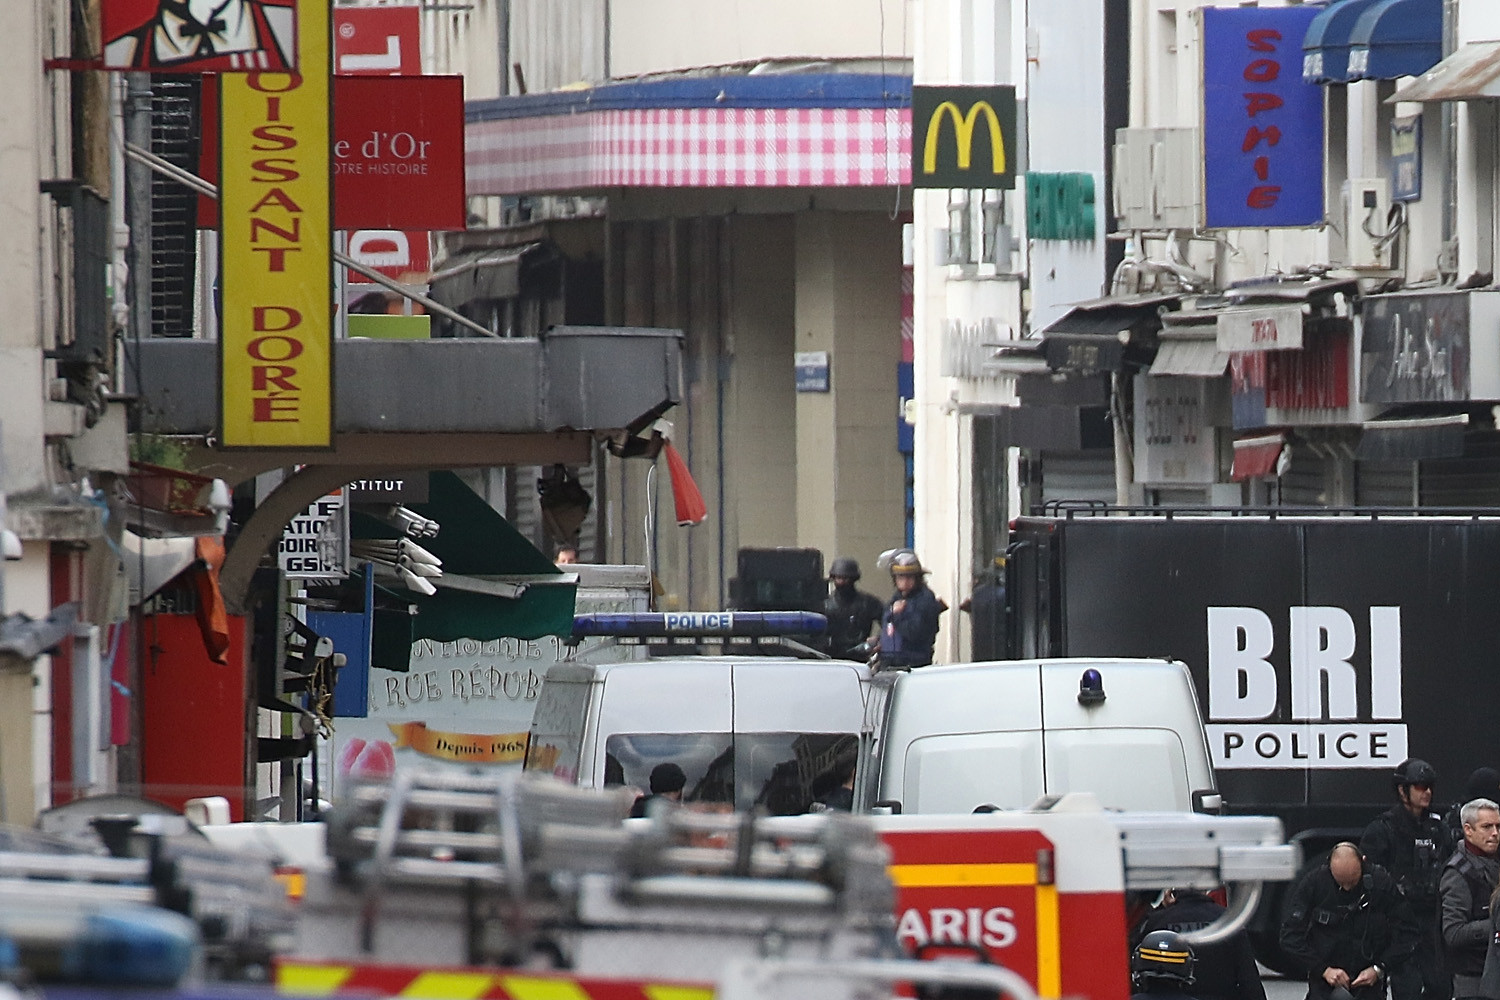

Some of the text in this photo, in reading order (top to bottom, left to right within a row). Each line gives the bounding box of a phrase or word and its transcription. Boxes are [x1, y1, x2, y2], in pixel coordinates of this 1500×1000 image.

[361, 131, 431, 160] d'Or
[246, 73, 304, 272] OISSANT
[368, 163, 428, 175] HISTOIRE
[247, 306, 304, 422] DORÉ
[350, 480, 404, 491] STITUT
[667, 613, 731, 631] POLICE
[1207, 606, 1402, 721] BRI
[436, 738, 525, 756] Depuis 1968
[1224, 732, 1389, 760] POLICE
[896, 907, 1018, 948] ARIS
